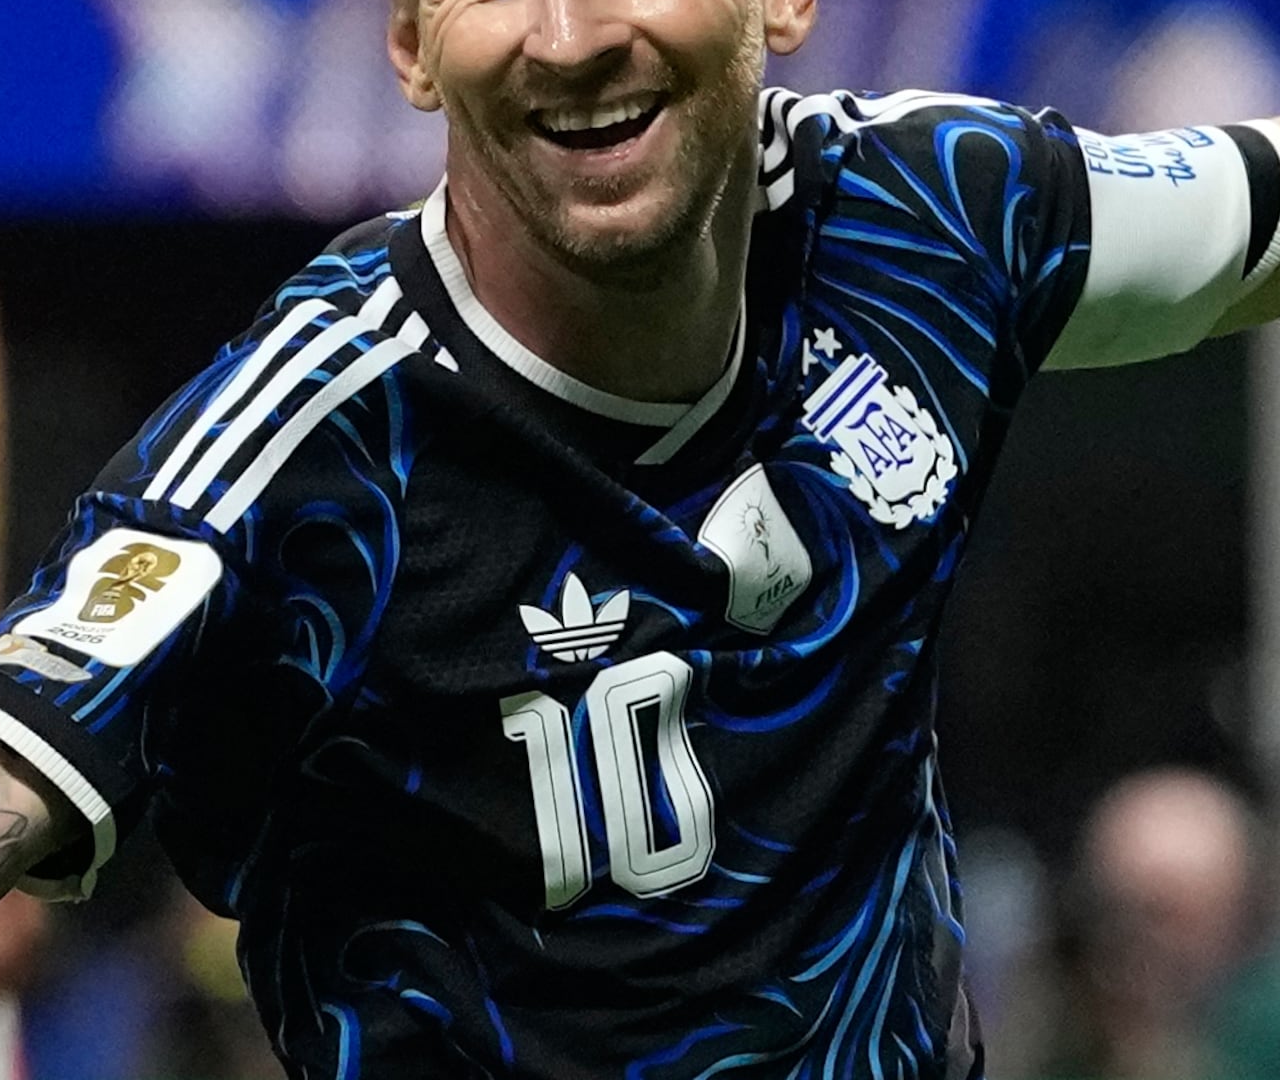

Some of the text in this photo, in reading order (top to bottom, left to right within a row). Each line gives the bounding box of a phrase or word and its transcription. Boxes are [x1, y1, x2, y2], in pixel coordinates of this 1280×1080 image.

[846, 401, 918, 479] AFA
[90, 603, 116, 617] FIFA
[755, 574, 794, 610] FIFA
[46, 626, 106, 644] 2026
[499, 650, 716, 911] 10
